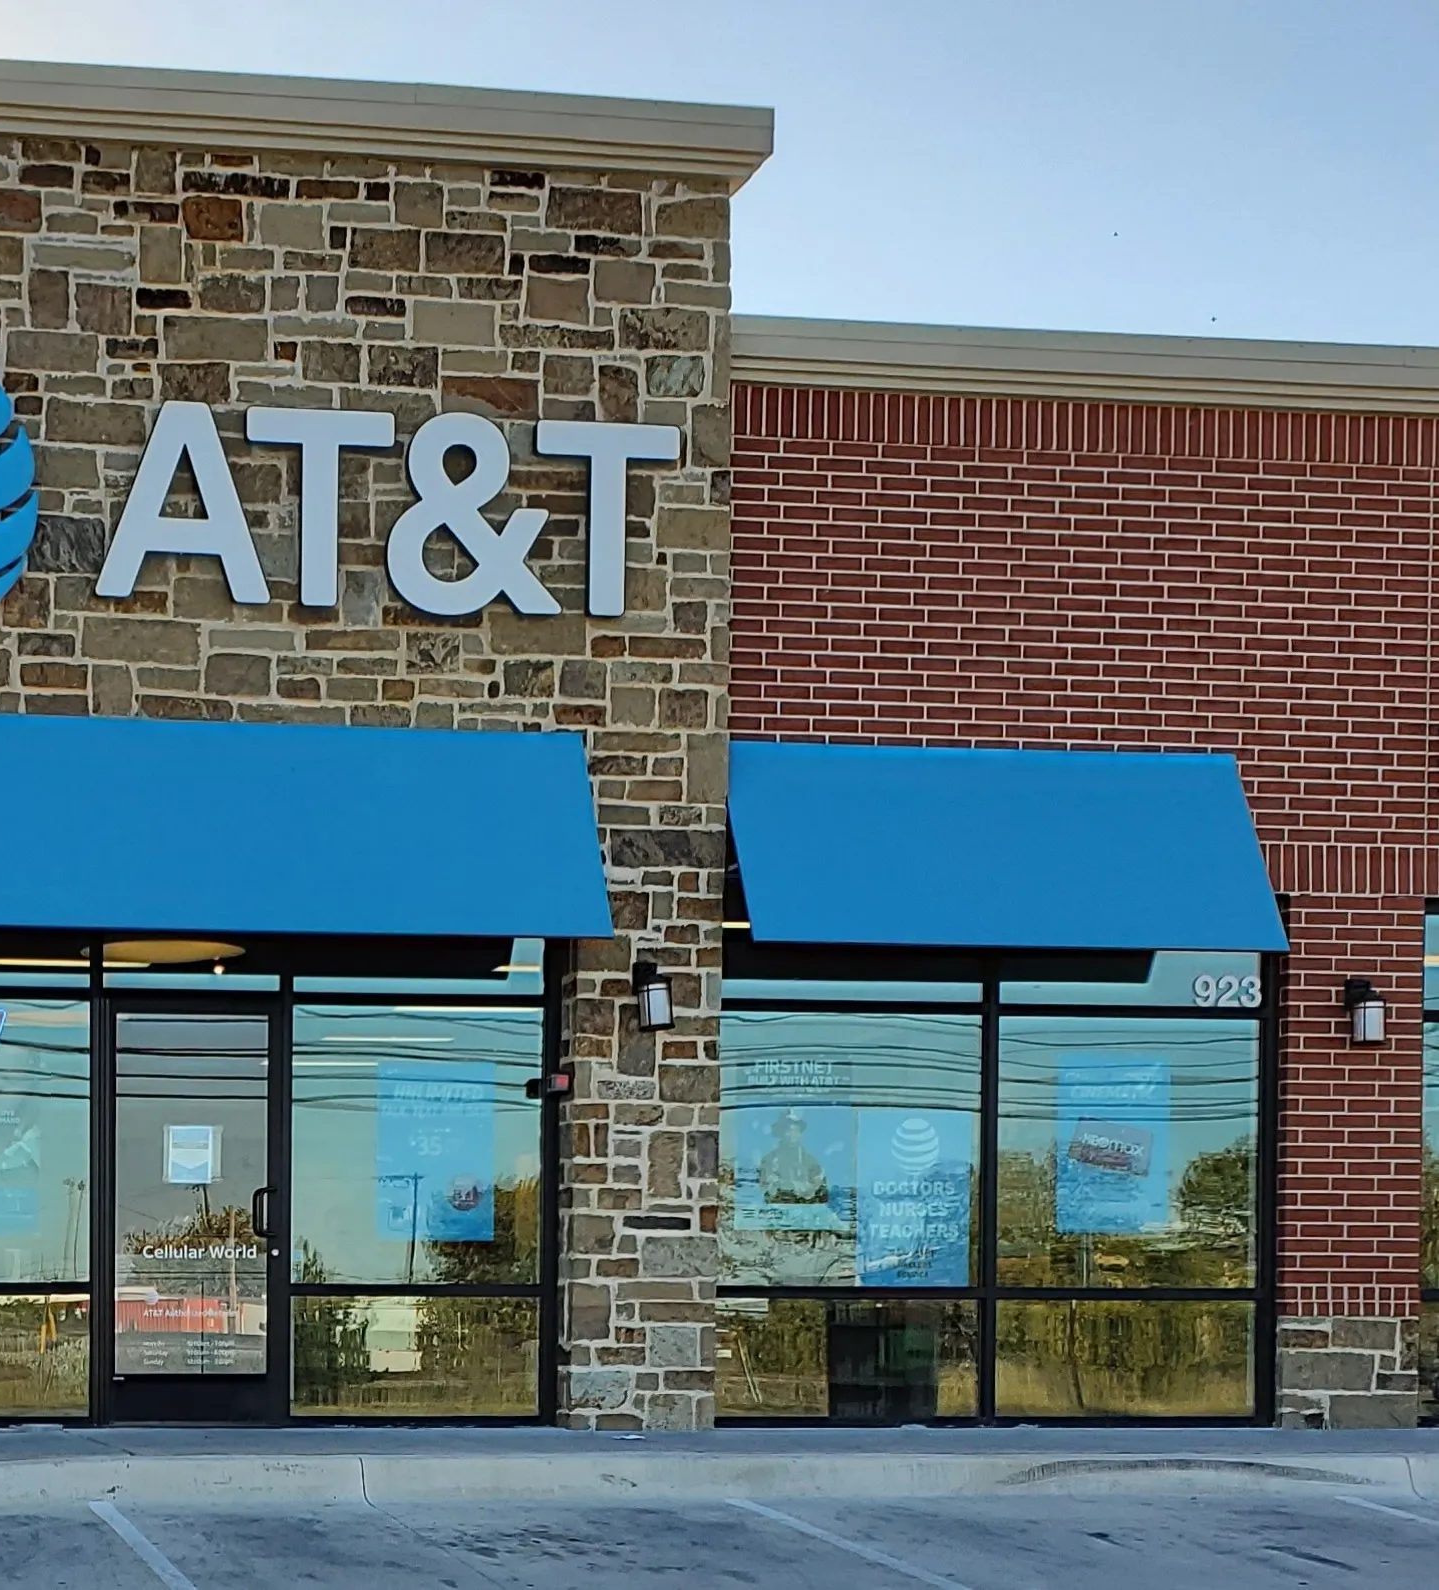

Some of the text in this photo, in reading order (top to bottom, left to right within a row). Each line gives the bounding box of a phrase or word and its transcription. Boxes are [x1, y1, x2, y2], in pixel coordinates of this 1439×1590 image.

[95, 400, 681, 617] AT&T
[1194, 974, 1262, 1007] 923
[779, 1075, 809, 1086] WITH
[873, 1180, 956, 1196] DOCTORS
[879, 1202, 948, 1217] NURSES
[869, 1222, 960, 1240] TEACHERS
[142, 1244, 258, 1260] Cellular World
[143, 1308, 163, 1318] AT&T
